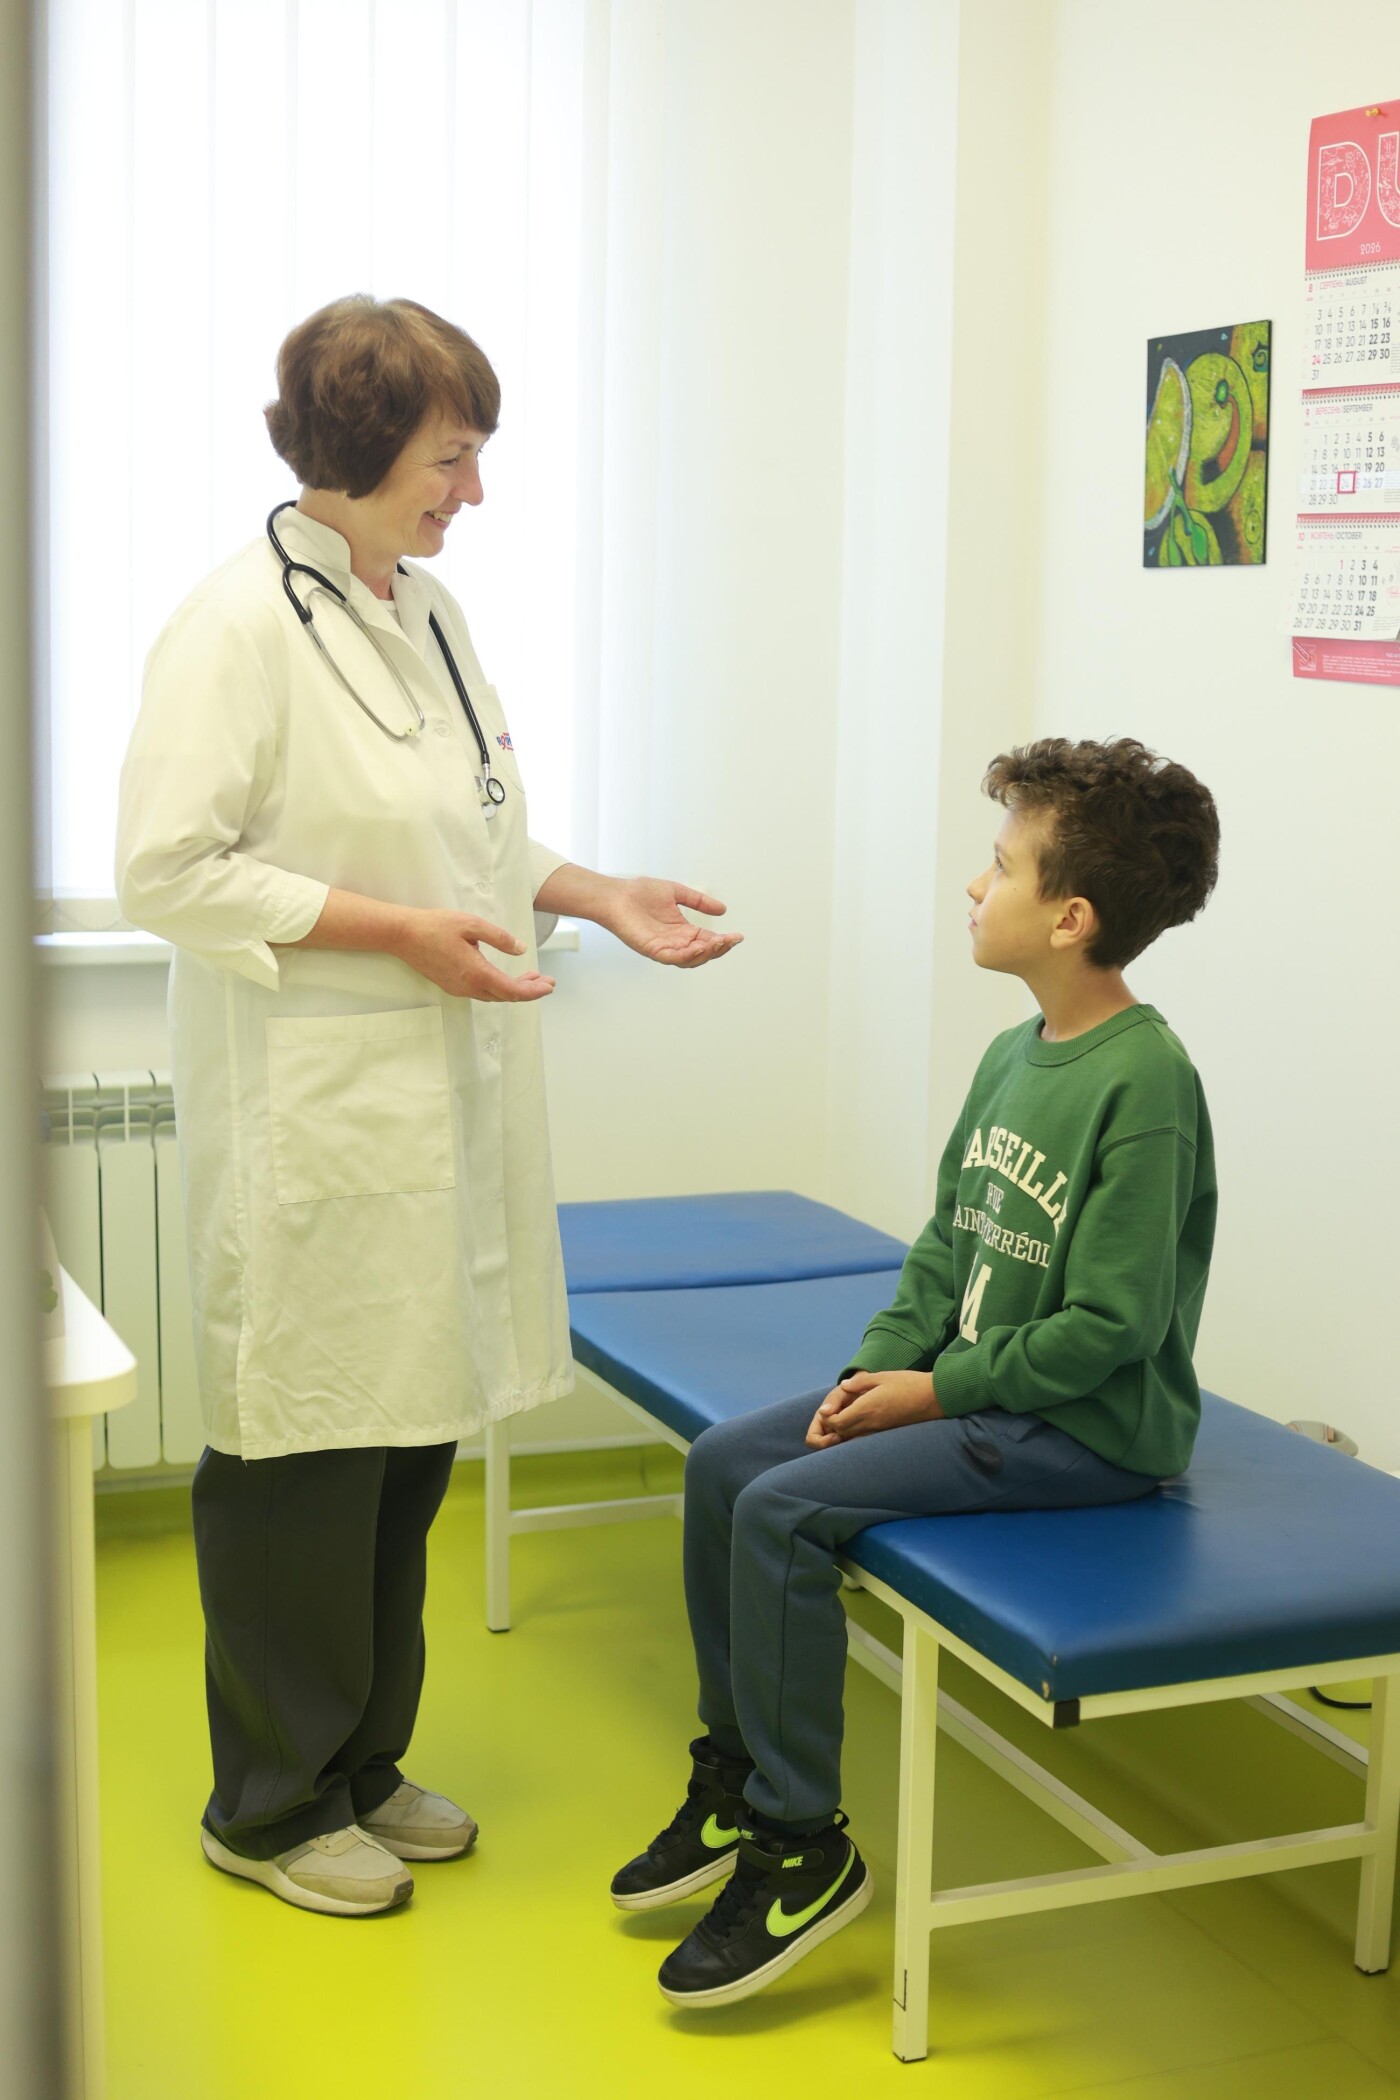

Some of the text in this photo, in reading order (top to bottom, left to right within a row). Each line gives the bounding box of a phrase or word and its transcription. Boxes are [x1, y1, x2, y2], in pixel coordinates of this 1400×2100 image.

[1360, 242, 1381, 255] 2026
[1345, 276, 1367, 286] AUGUST
[1317, 309, 1322, 320] 3
[1327, 308, 1332, 318] 4
[1338, 306, 1343, 318] 5
[1350, 306, 1355, 317] 6
[1362, 304, 1366, 315] 7
[1315, 324, 1322, 335] 10
[1337, 322, 1344, 333] 12
[1348, 321, 1355, 332] 13
[1359, 319, 1366, 330] 14
[1371, 318, 1378, 329] 15
[1383, 317, 1390, 328] 16
[1315, 333, 1390, 350] 17 18 19 20 21 22 23
[1312, 348, 1390, 365] 24 25 26 27 28 29 30
[1312, 370, 1319, 380] 31
[1343, 404, 1373, 413] SEPTEMBER
[1334, 434, 1338, 444] 2
[1345, 433, 1350, 444] 3
[1357, 433, 1361, 442] 4
[1368, 432, 1372, 442] 5
[1379, 432, 1384, 441] 6
[1313, 450, 1317, 460] 7
[1322, 449, 1327, 460] 8
[1333, 448, 1338, 459] 9
[1344, 448, 1351, 459] 10
[1366, 448, 1373, 457] 12
[1377, 447, 1384, 457] 13
[1312, 465, 1318, 474] 14
[1321, 465, 1327, 474] 15
[1365, 463, 1372, 472] 19
[1375, 462, 1384, 472] 20
[1363, 478, 1371, 489] 26
[1375, 478, 1383, 488] 27
[1309, 494, 1338, 505] 28 29 30
[1336, 532, 1362, 540] OCTOBER
[1350, 560, 1355, 570] 2
[1361, 560, 1366, 570] 3
[1373, 560, 1378, 570] 4
[1304, 574, 1378, 585] 5 6 7 8 9 10 11
[1301, 589, 1377, 601] 12 13 14 15 16 17 18
[1297, 603, 1375, 616] 19 20 21 22 23 24 25
[1293, 617, 1302, 628] 26
[1304, 618, 1314, 629] 27
[1315, 619, 1326, 630] 28
[1328, 619, 1338, 630] 29
[1340, 620, 1351, 631] 30
[1354, 621, 1362, 631] 31
[985, 1181, 1004, 1215] RUE
[782, 1856, 803, 1868] NIKE
